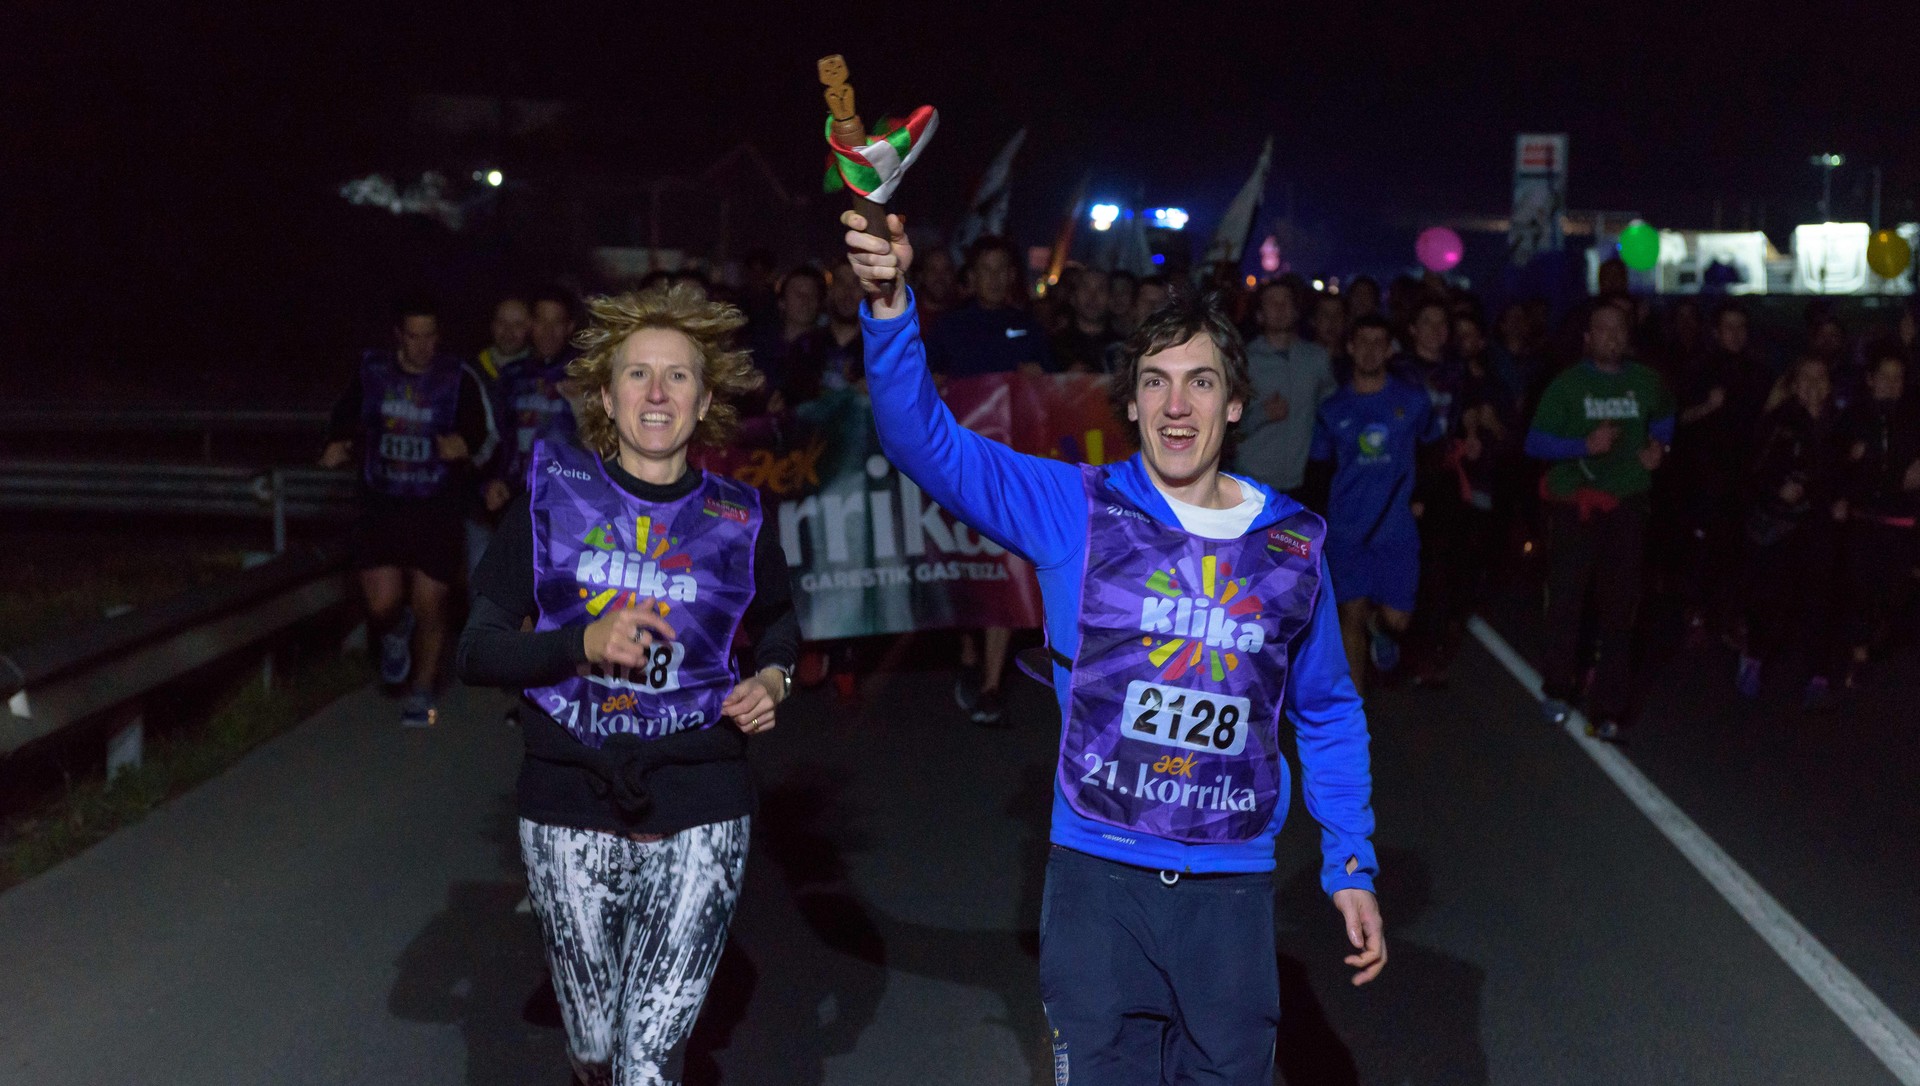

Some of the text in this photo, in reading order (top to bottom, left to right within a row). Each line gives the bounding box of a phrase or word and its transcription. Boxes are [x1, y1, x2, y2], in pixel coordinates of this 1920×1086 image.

[563, 468, 592, 481] eitb
[576, 550, 697, 602] Klika
[1140, 597, 1265, 653] Klika
[1133, 688, 1239, 750] 2128
[1080, 752, 1257, 812] 21. korrika
[1153, 752, 1198, 778] aek
